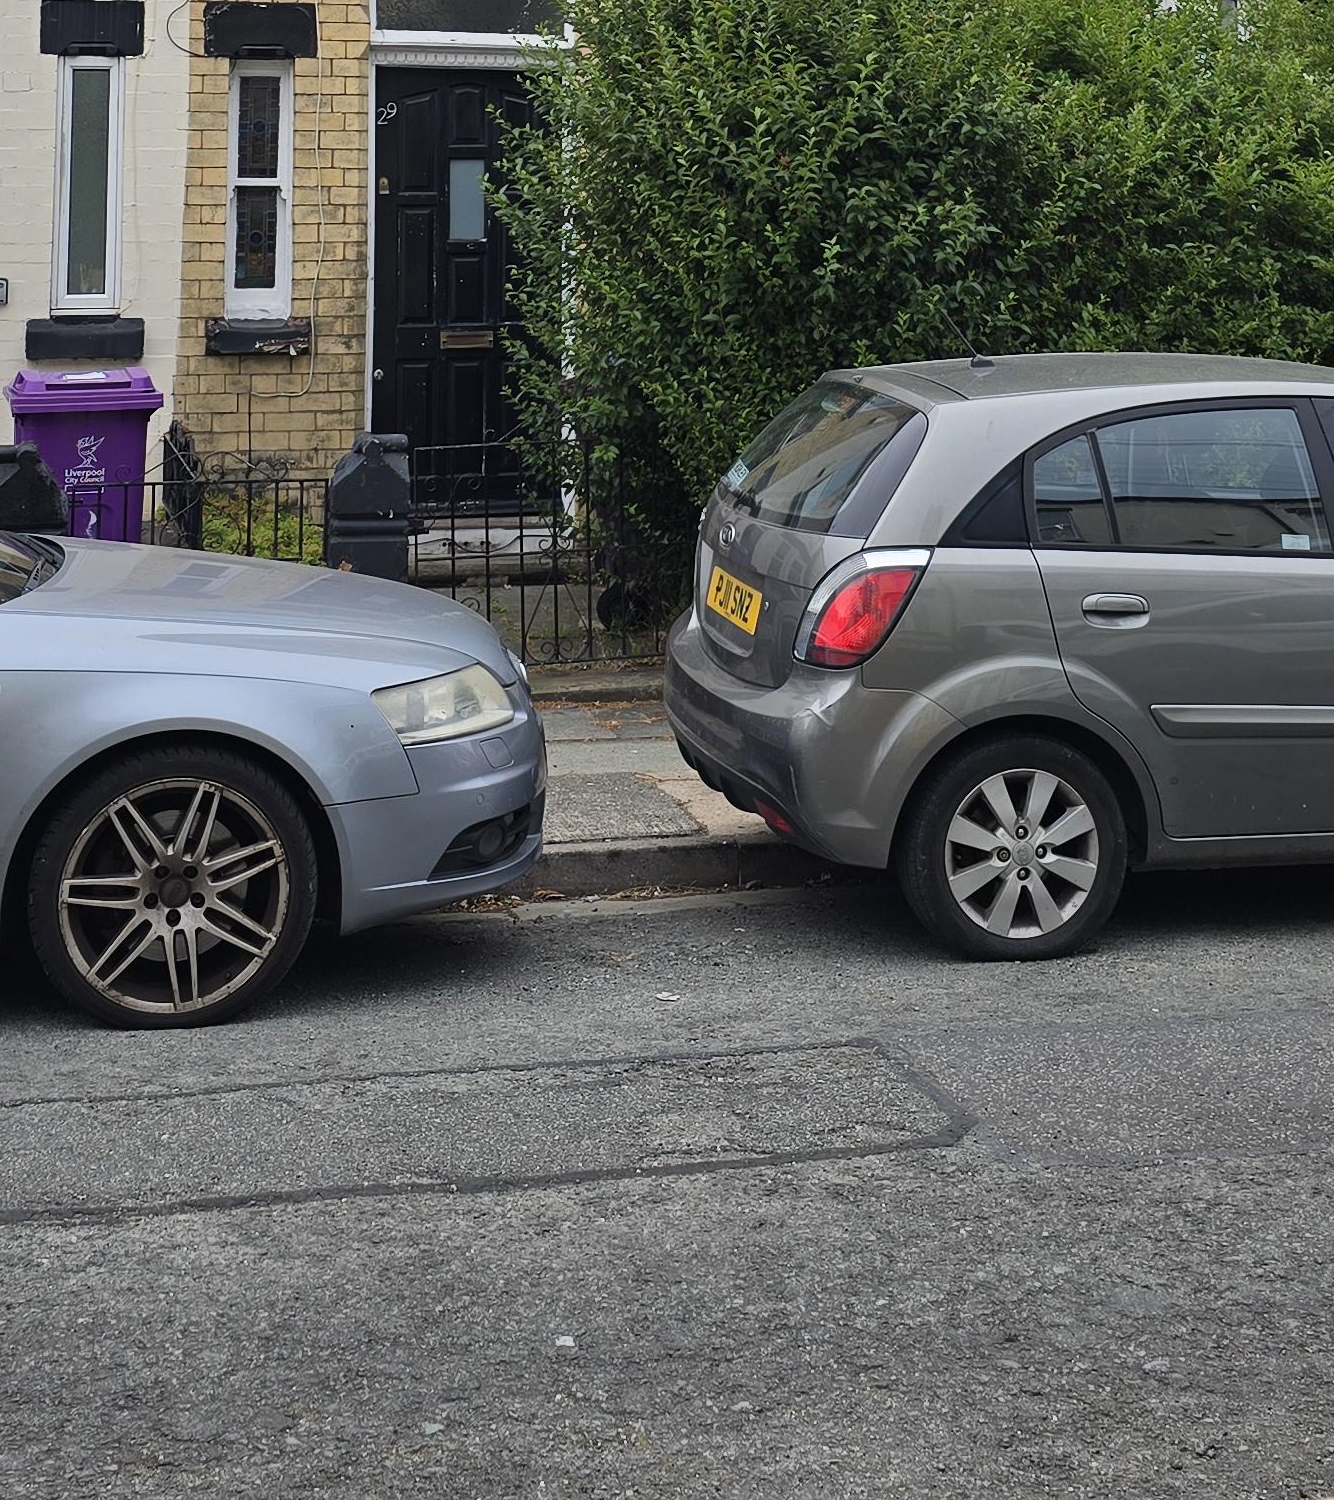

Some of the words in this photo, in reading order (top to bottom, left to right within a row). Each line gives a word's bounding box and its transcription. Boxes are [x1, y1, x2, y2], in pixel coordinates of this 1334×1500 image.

[377, 102, 397, 125] 29
[65, 467, 105, 479] Liverpool
[65, 476, 78, 485] City
[731, 585, 754, 624] SNZ
